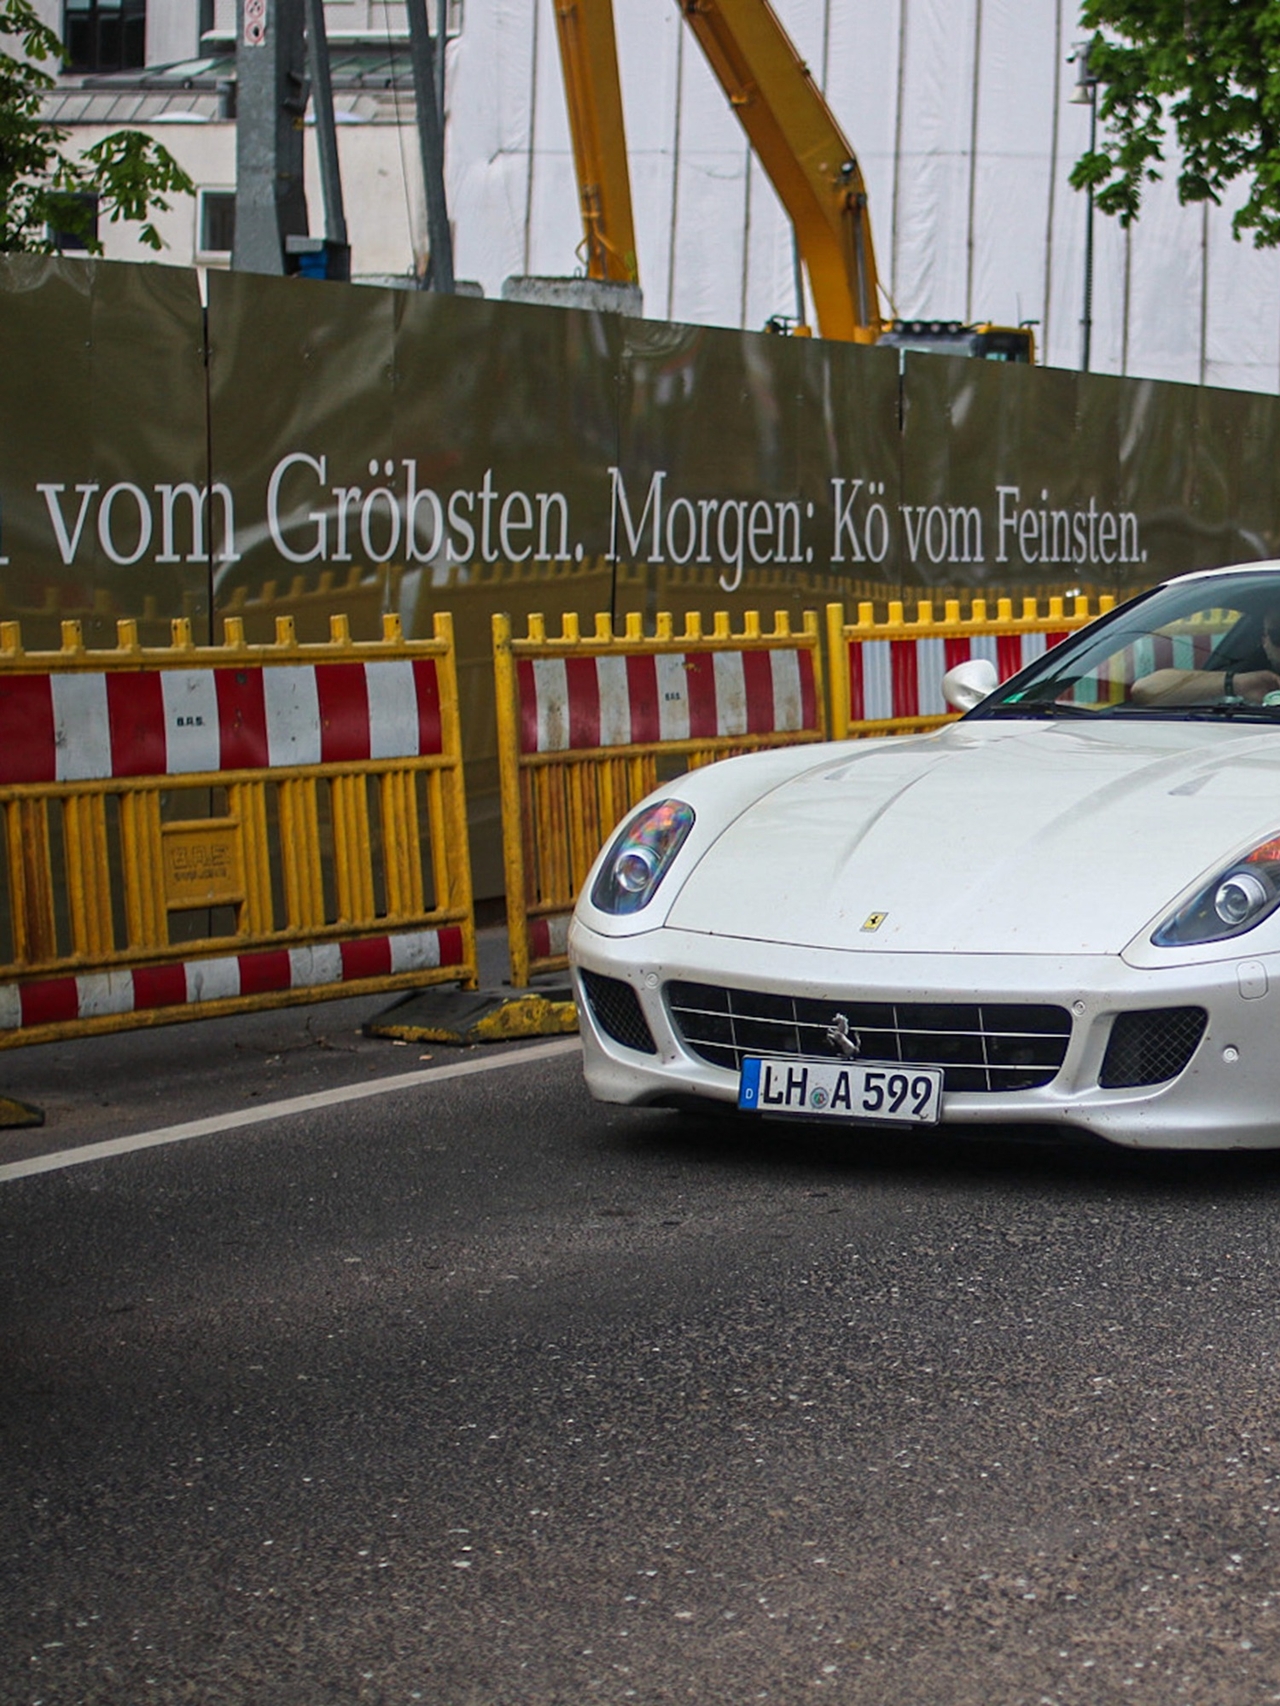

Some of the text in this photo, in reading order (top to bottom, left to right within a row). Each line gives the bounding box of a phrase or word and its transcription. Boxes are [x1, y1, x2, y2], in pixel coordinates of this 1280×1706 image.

[36, 451, 1148, 592] vom Gröbsten. Morgen: Kö vom Feinsten.
[762, 1065, 934, 1116] LH A 599
